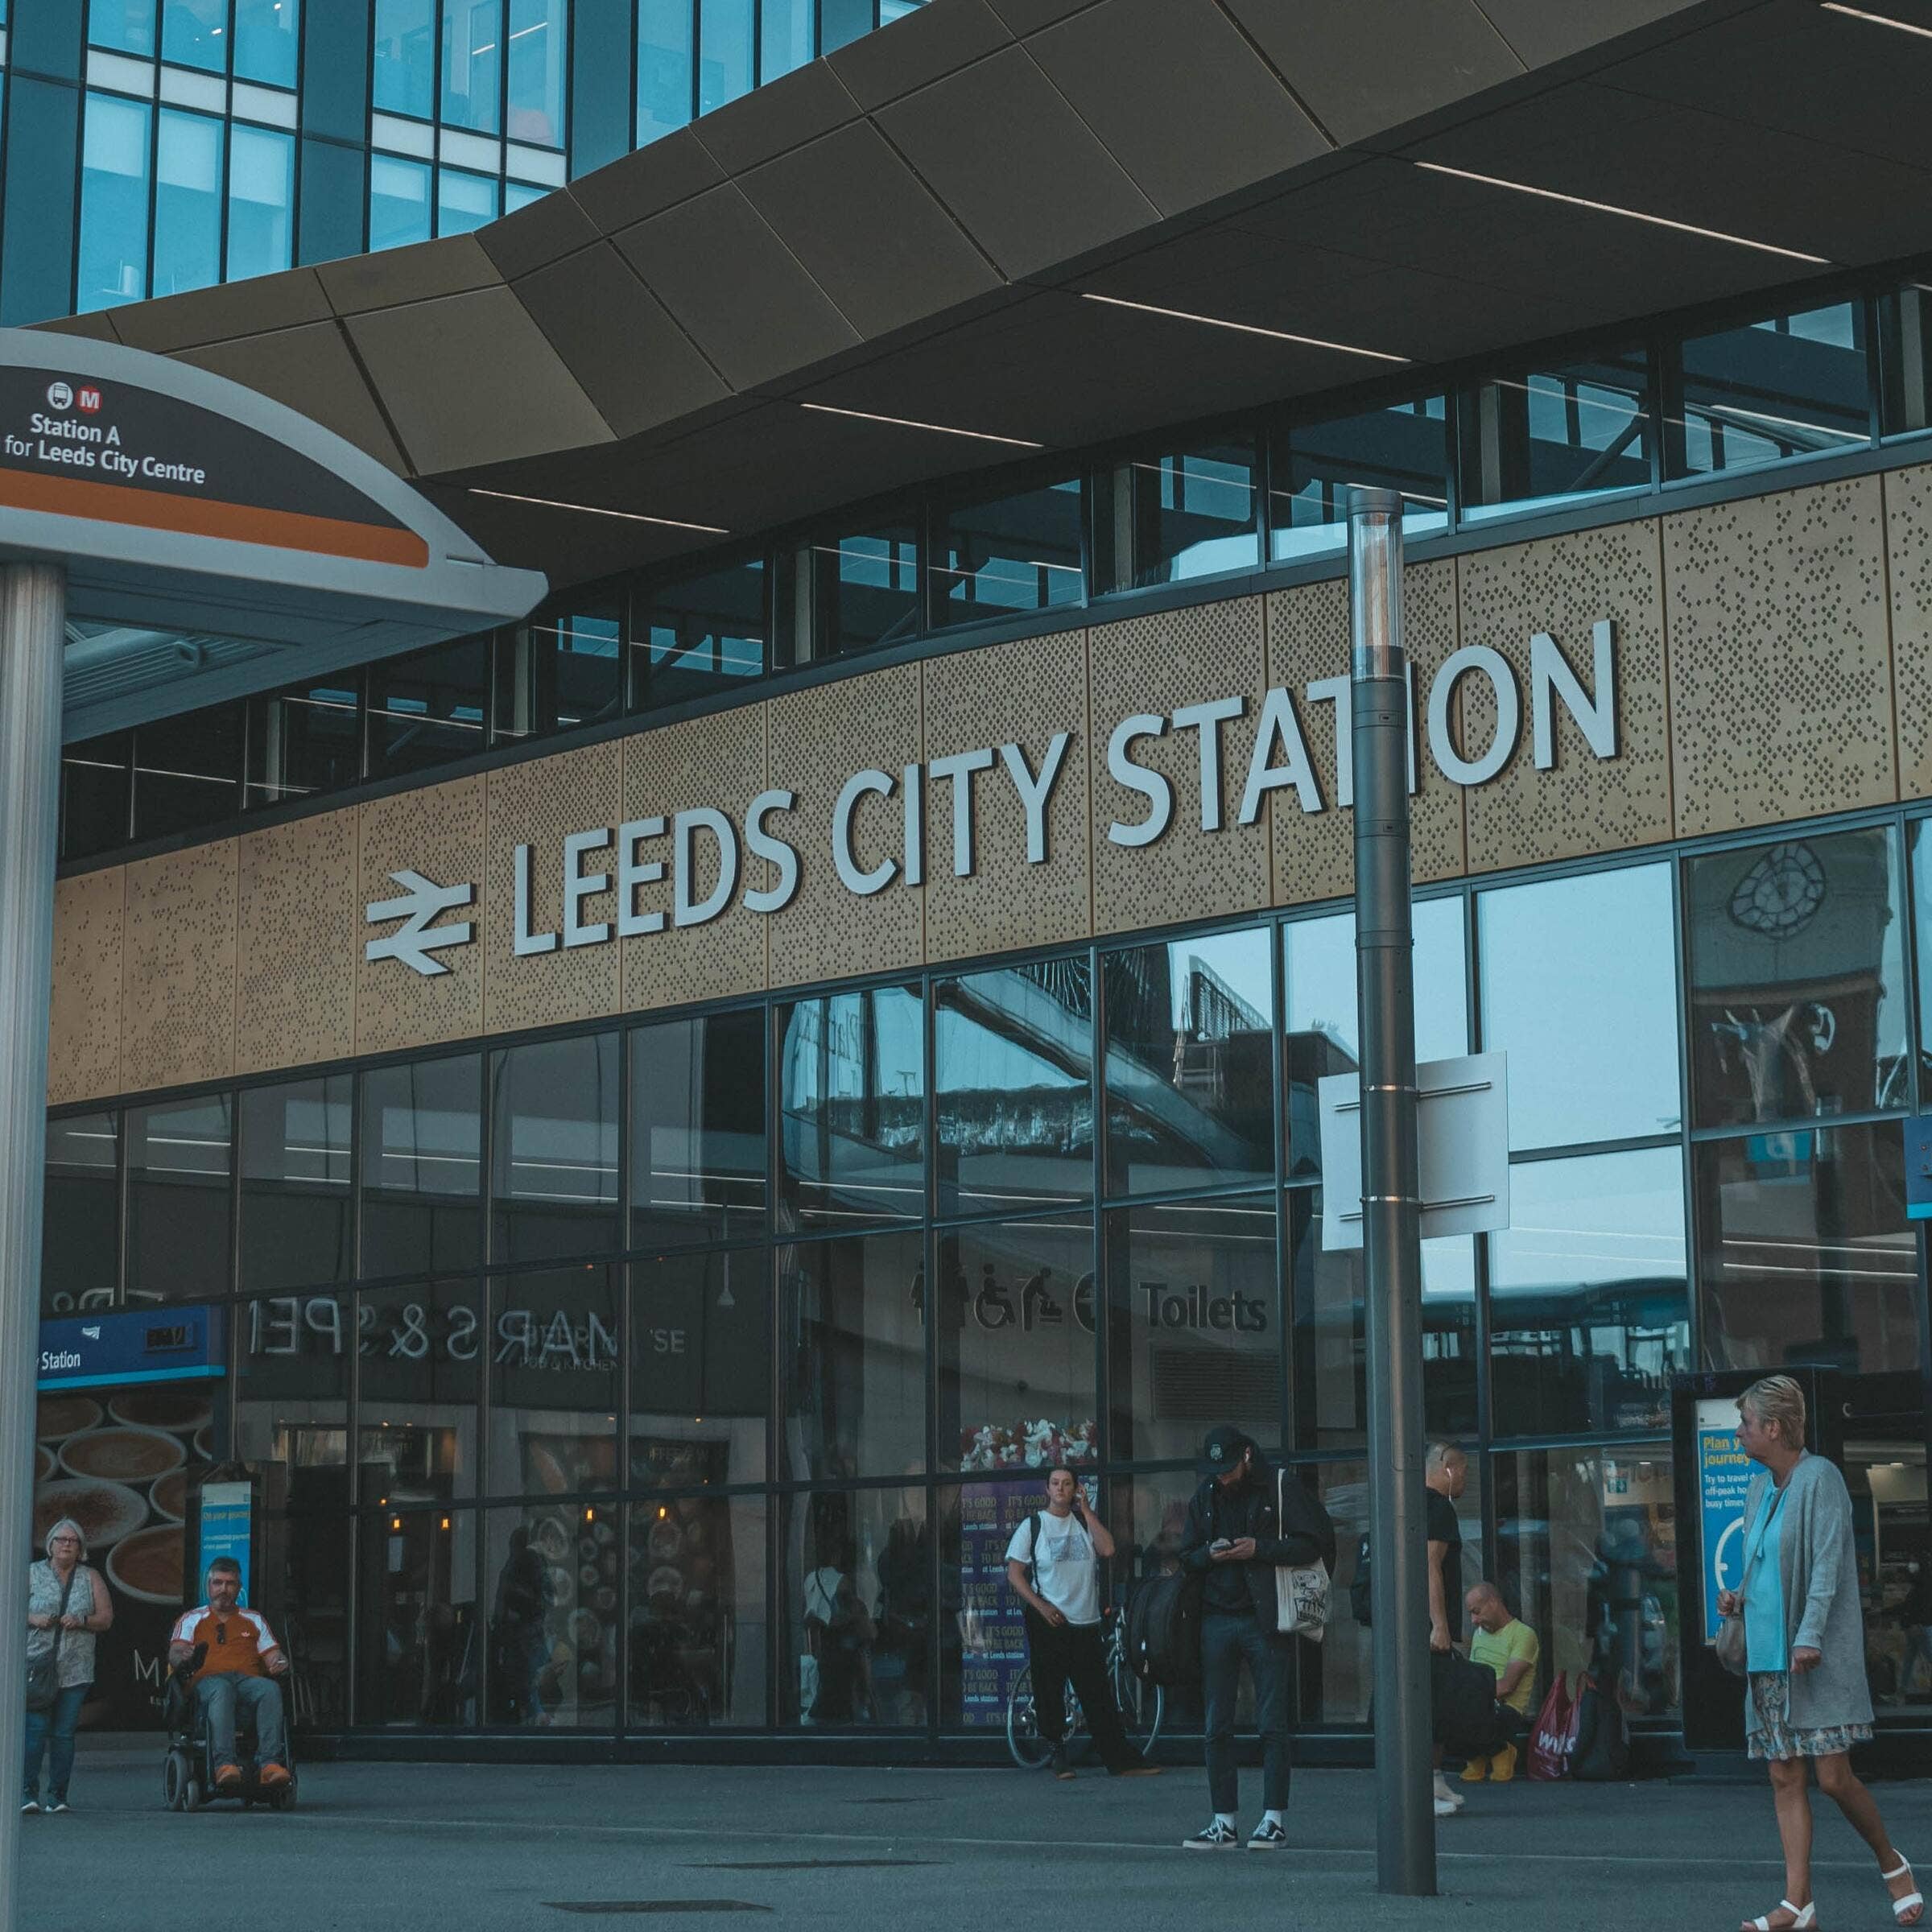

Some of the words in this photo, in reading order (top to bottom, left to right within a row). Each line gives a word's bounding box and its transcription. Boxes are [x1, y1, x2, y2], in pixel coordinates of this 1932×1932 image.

[80, 390, 99, 409] M
[31, 413, 101, 443] Station
[105, 426, 121, 445] A
[5, 435, 33, 456] for
[39, 440, 95, 467] Leeds
[101, 450, 139, 477] City
[142, 456, 205, 484] Centre
[514, 789, 800, 956] LEEDS
[832, 733, 1071, 896] CITY
[1137, 1281, 1267, 1331] Toilets
[42, 1352, 80, 1370] Station
[1704, 1436, 1730, 1451] Plan
[1704, 1452, 1750, 1469] journey
[1705, 1474, 1716, 1486] Try
[1717, 1475, 1725, 1483] to
[1727, 1472, 1748, 1483] travel
[1706, 1486, 1736, 1497] off-peak
[974, 1496, 997, 1508] GOOD
[1008, 1496, 1022, 1507] IT'S
[1024, 1495, 1046, 1506] GOOD
[1706, 1499, 1723, 1509] busy
[1001, 1625, 1023, 1637] GOOD
[989, 1650, 1005, 1659] Leeds
[976, 1669, 998, 1680] GOOD
[964, 1694, 979, 1703] Leeds
